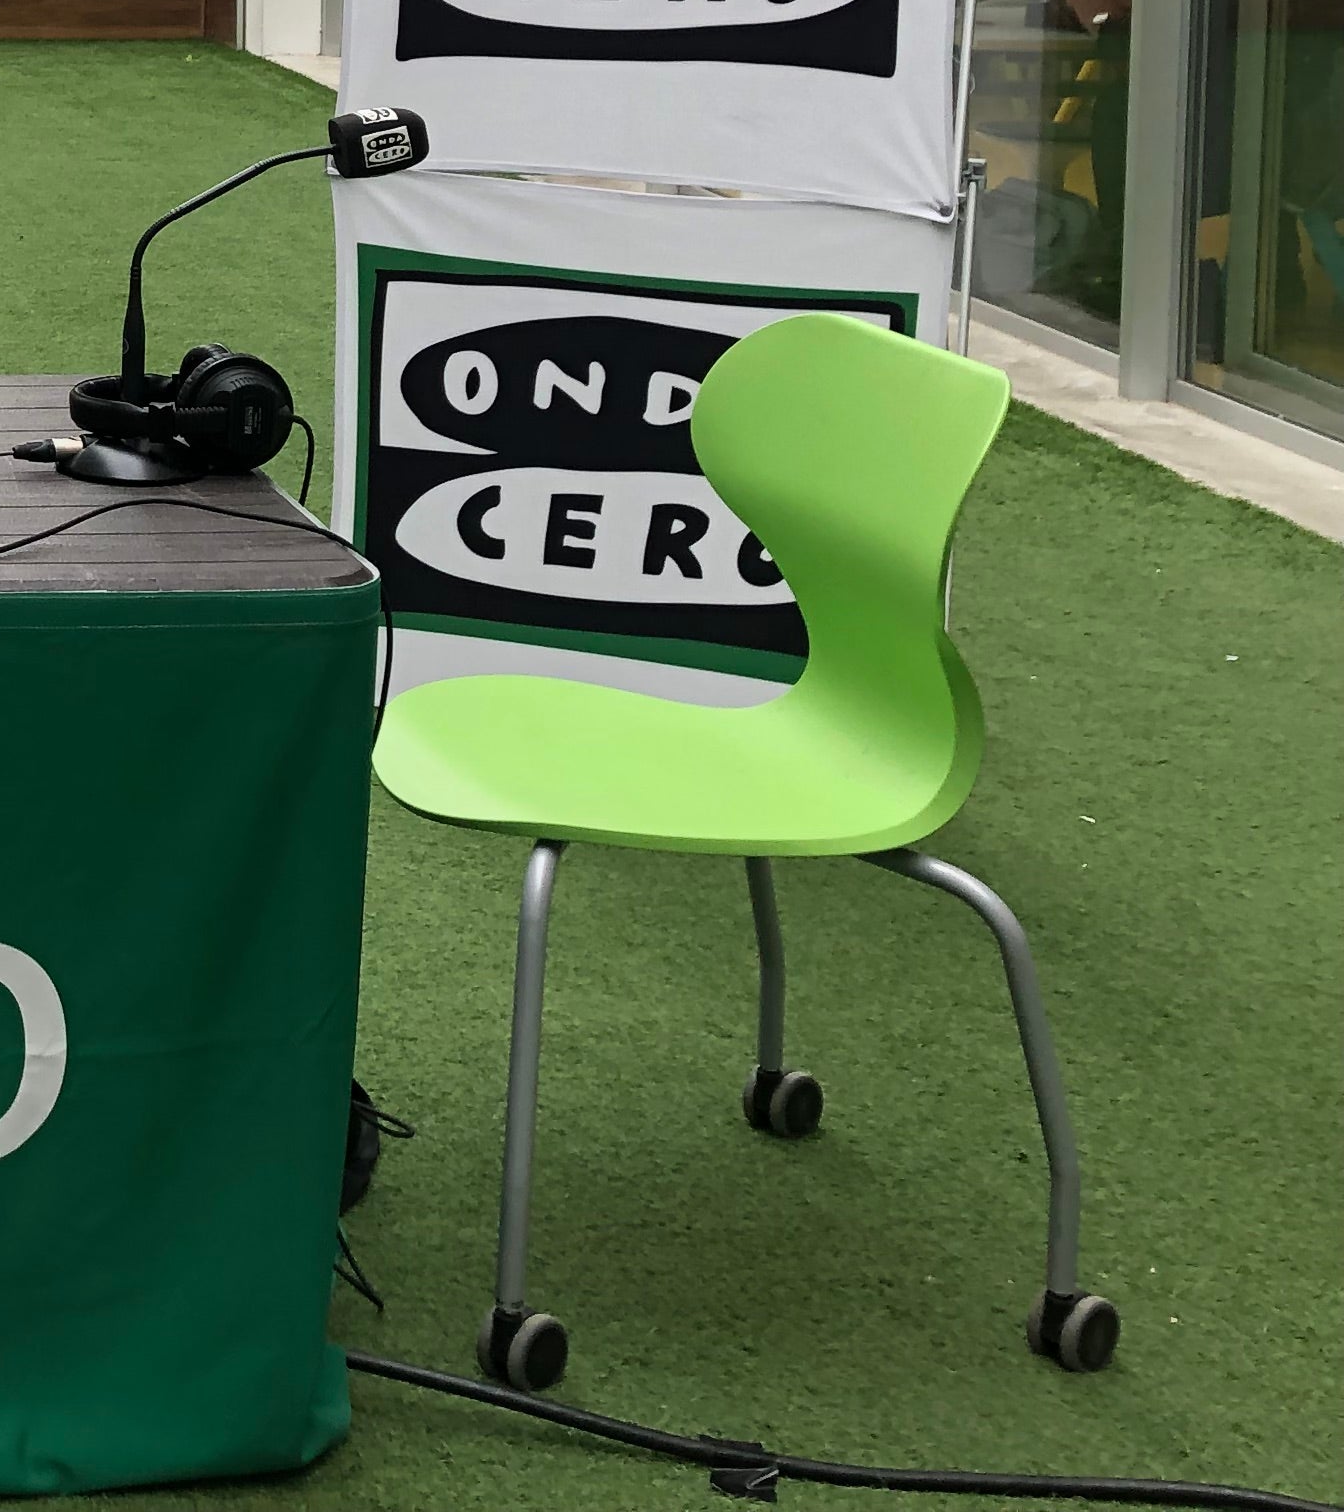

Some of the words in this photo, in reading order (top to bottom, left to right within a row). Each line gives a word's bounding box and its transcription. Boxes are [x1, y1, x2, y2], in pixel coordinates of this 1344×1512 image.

[370, 135, 403, 148] ONDA
[375, 148, 404, 159] CERO
[443, 350, 705, 426] OND
